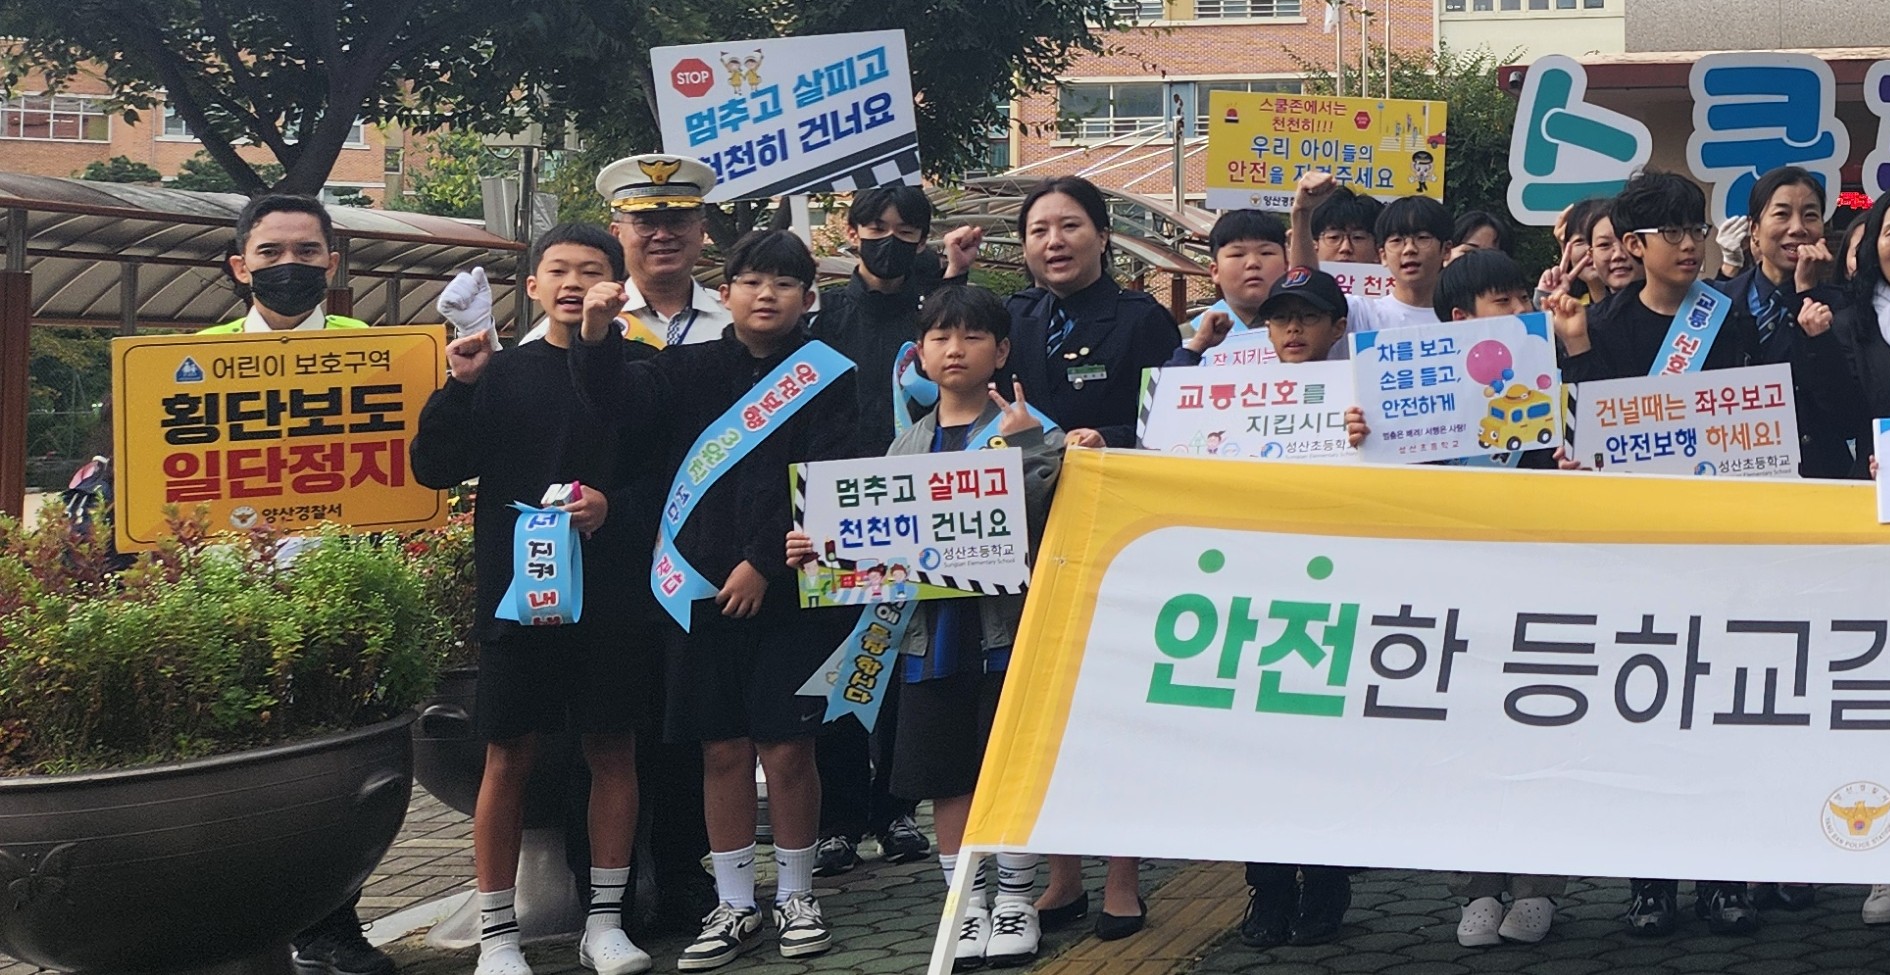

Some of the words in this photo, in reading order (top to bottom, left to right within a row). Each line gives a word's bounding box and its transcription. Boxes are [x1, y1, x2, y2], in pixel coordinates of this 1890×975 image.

[676, 70, 709, 85] STOP
[685, 84, 783, 147] 멈추고
[792, 46, 889, 109] 살피고
[1259, 98, 1348, 116] 스쿨존에서는
[798, 92, 895, 153] 건너요
[1272, 116, 1334, 134] 천천히!!!
[1251, 136, 1290, 160] 우리
[1301, 139, 1373, 163] 아이들의
[1228, 161, 1284, 185] 안전을
[212, 354, 286, 379] 어린이
[295, 349, 390, 375] 보호구역
[1377, 340, 1414, 362] 차를
[1421, 338, 1462, 356] 보고,
[1380, 368, 1413, 391] 손을
[1177, 380, 1325, 410] 교통신호를
[1382, 393, 1456, 419] 안전하게
[1596, 394, 1686, 427] 건널때는
[1695, 384, 1786, 416] 좌우보고
[161, 384, 405, 445] 횡단보도
[1606, 428, 1697, 464] 안전보행
[1705, 421, 1782, 452] 하세요!
[163, 439, 405, 503] 일단정지
[1719, 454, 1791, 473] 성산초등학교
[836, 474, 916, 508] 멈추고
[928, 468, 1008, 502] 살피고
[262, 503, 342, 523] 양산경찰서
[839, 513, 919, 549] 천천히
[932, 508, 1011, 542] 건너요
[943, 543, 1015, 561] 성산초등학교
[1145, 589, 1468, 721] 안전한
